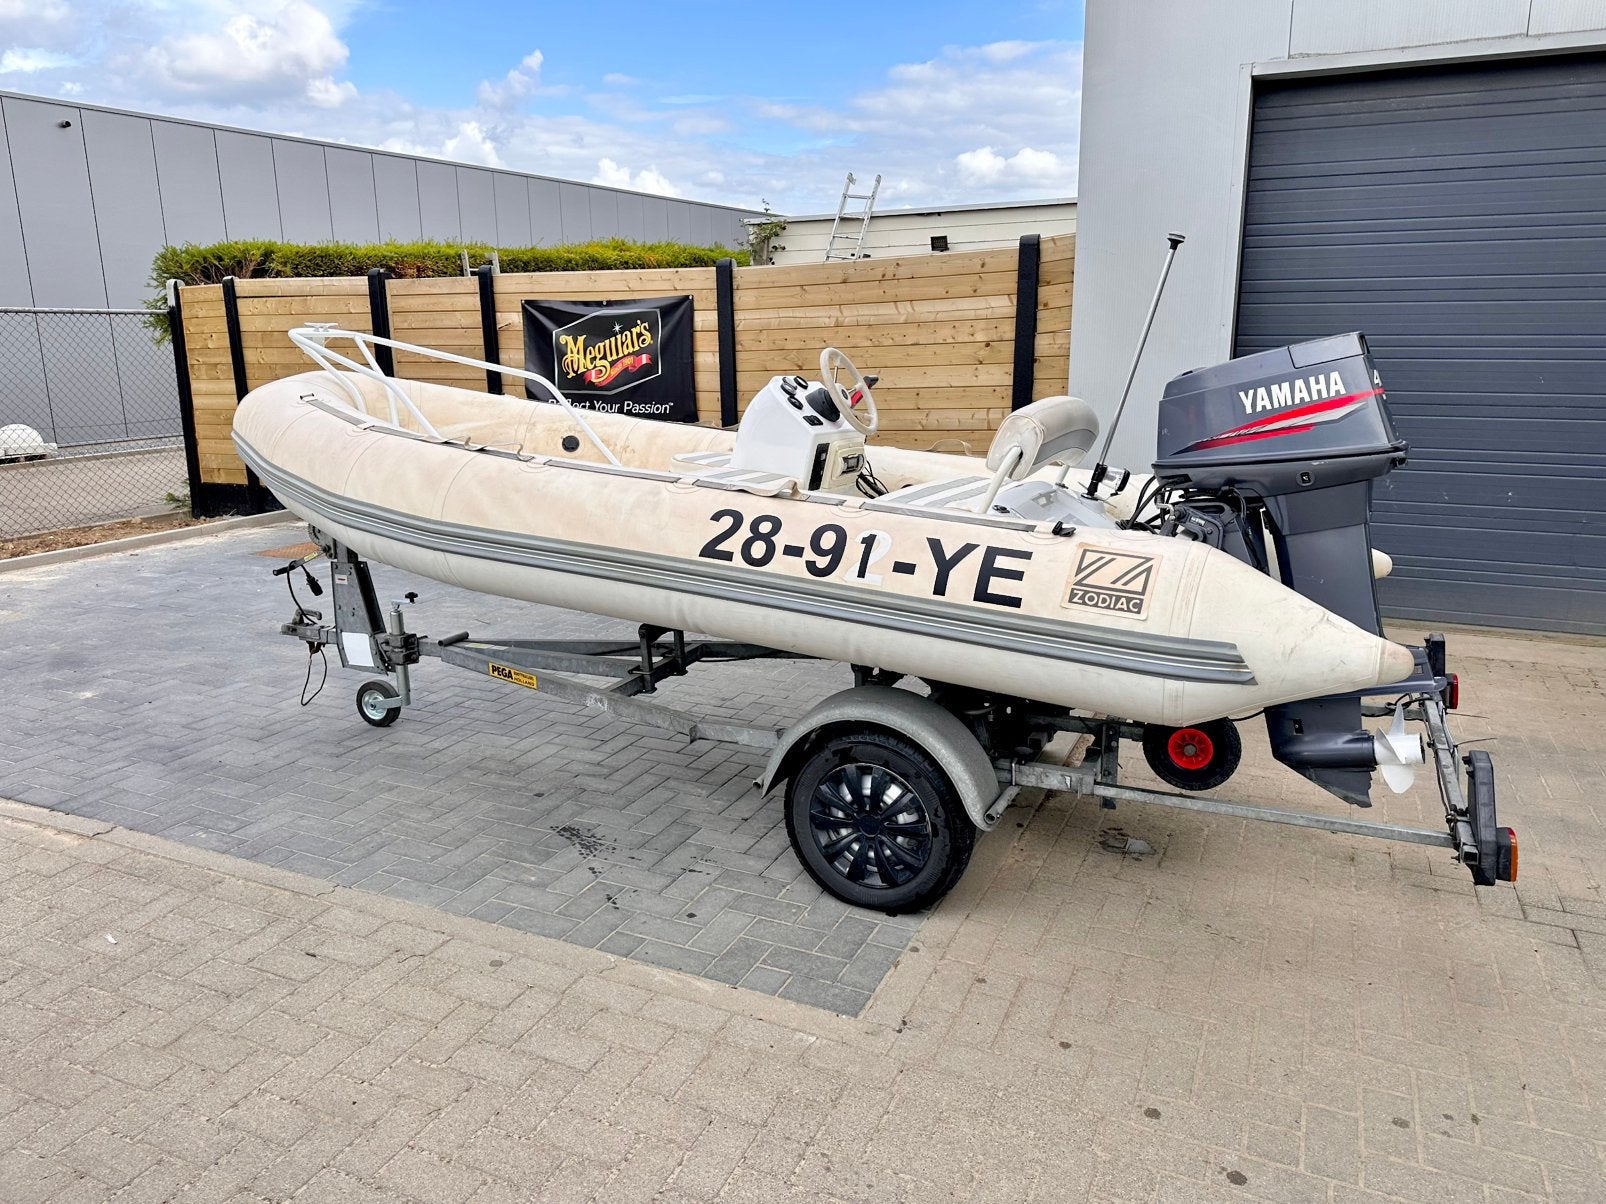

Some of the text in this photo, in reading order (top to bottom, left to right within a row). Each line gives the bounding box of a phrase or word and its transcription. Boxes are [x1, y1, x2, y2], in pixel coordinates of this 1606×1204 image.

[559, 319, 653, 383] Meguiar's
[1238, 371, 1346, 414] YAMAHA
[594, 400, 620, 413] Your
[1071, 589, 1141, 612] ZODIAC
[491, 664, 514, 680] PEGA
